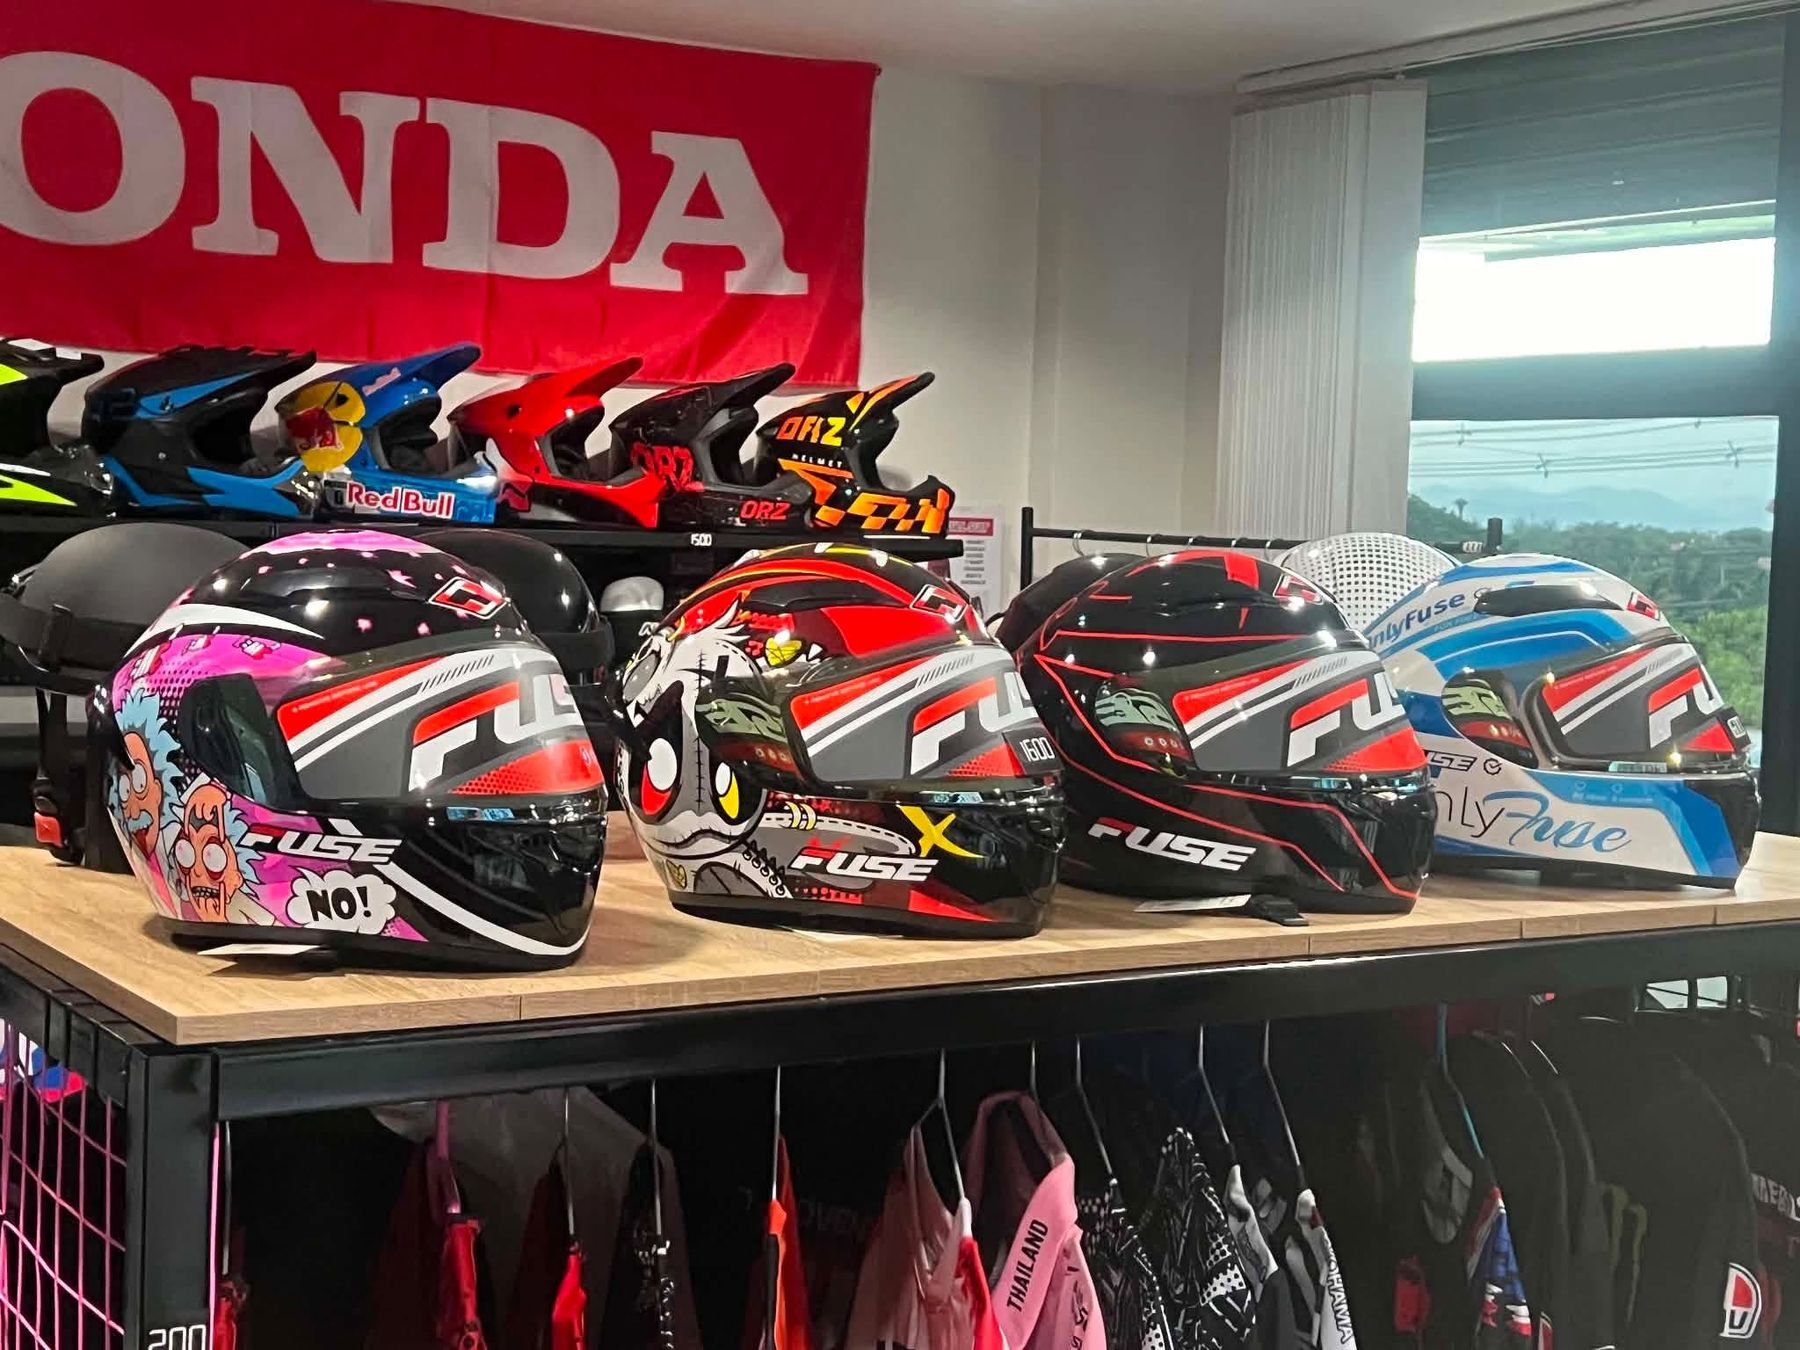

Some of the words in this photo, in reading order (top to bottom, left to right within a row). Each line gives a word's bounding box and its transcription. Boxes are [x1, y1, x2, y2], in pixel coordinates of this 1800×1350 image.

[0, 51, 808, 295] ONDA
[775, 416, 847, 447] ORZ
[346, 482, 400, 509] Red
[402, 488, 455, 519] Bull
[740, 501, 791, 520] ORZ
[1368, 593, 1466, 649] nlyFuse
[1019, 736, 1056, 763] 1600
[239, 824, 402, 863] FUSE
[1087, 816, 1257, 872] FUSE
[789, 848, 939, 882] FUSE
[306, 885, 372, 922] NO!
[1006, 1219, 1049, 1313] THAILAND
